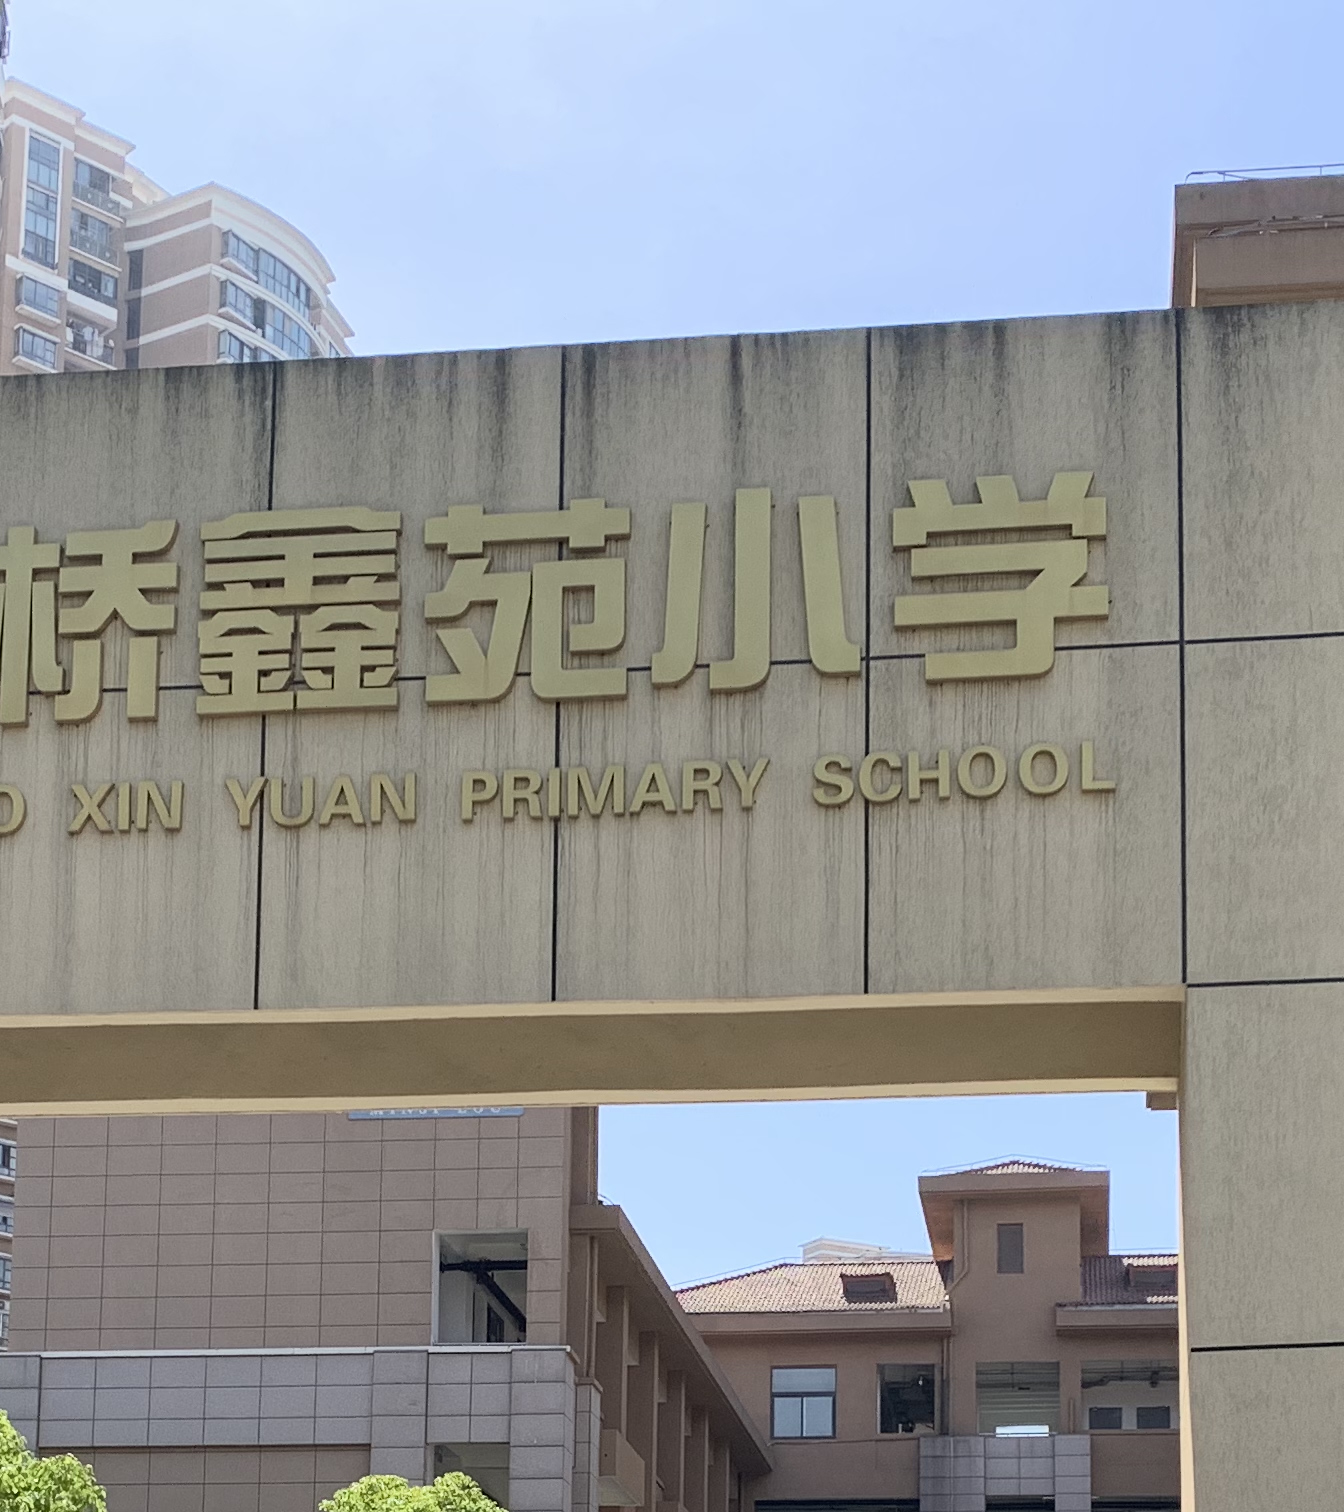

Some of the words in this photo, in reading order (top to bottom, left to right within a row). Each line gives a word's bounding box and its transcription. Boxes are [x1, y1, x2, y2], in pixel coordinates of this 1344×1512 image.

[67, 778, 185, 836] XIN
[225, 772, 418, 831] YUAN
[460, 756, 771, 824] PRIMARY
[811, 740, 1117, 807] SCHOOL
